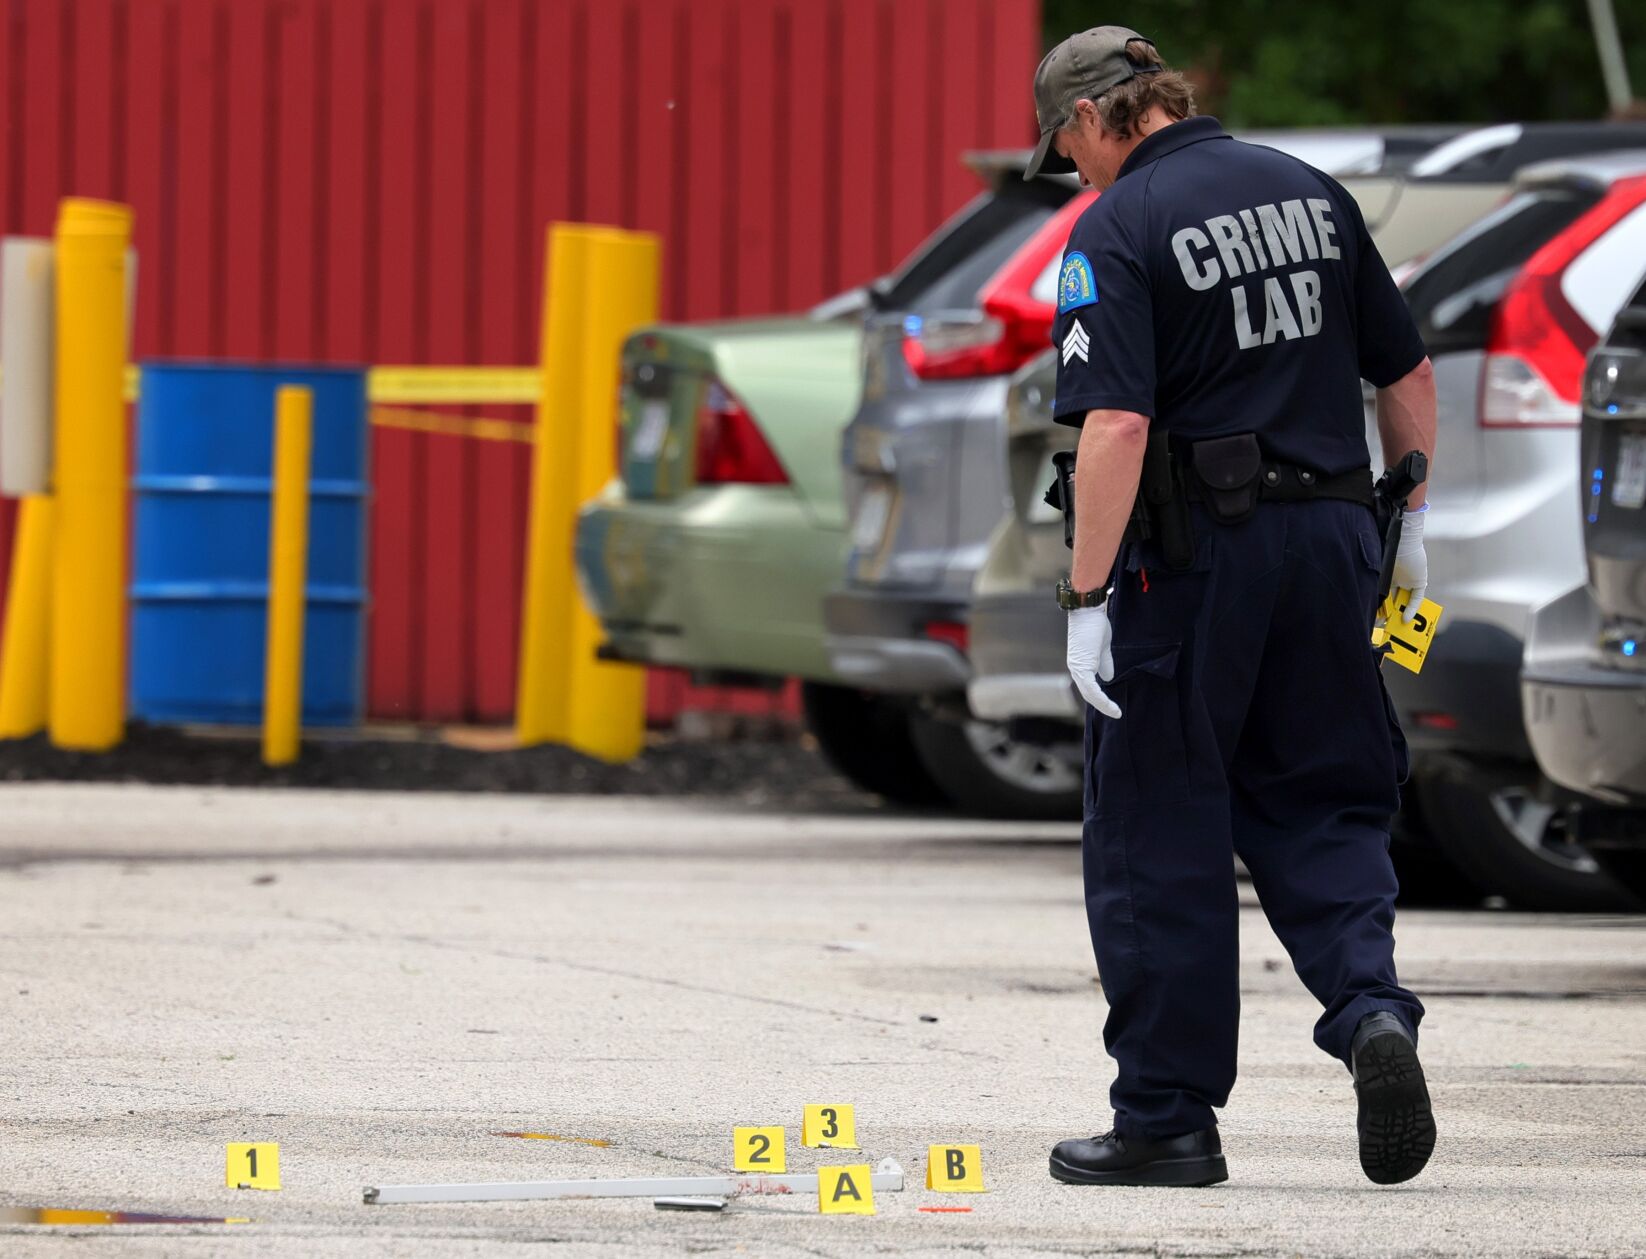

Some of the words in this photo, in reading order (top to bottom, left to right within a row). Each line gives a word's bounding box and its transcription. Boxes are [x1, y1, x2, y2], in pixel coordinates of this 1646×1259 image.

[1171, 198, 1341, 291] CRIME
[1231, 270, 1323, 350] LAB
[820, 1108, 839, 1138] 3
[245, 1148, 257, 1178] 1
[748, 1134, 771, 1163] 2
[945, 1149, 967, 1181] B
[832, 1172, 862, 1202] A
